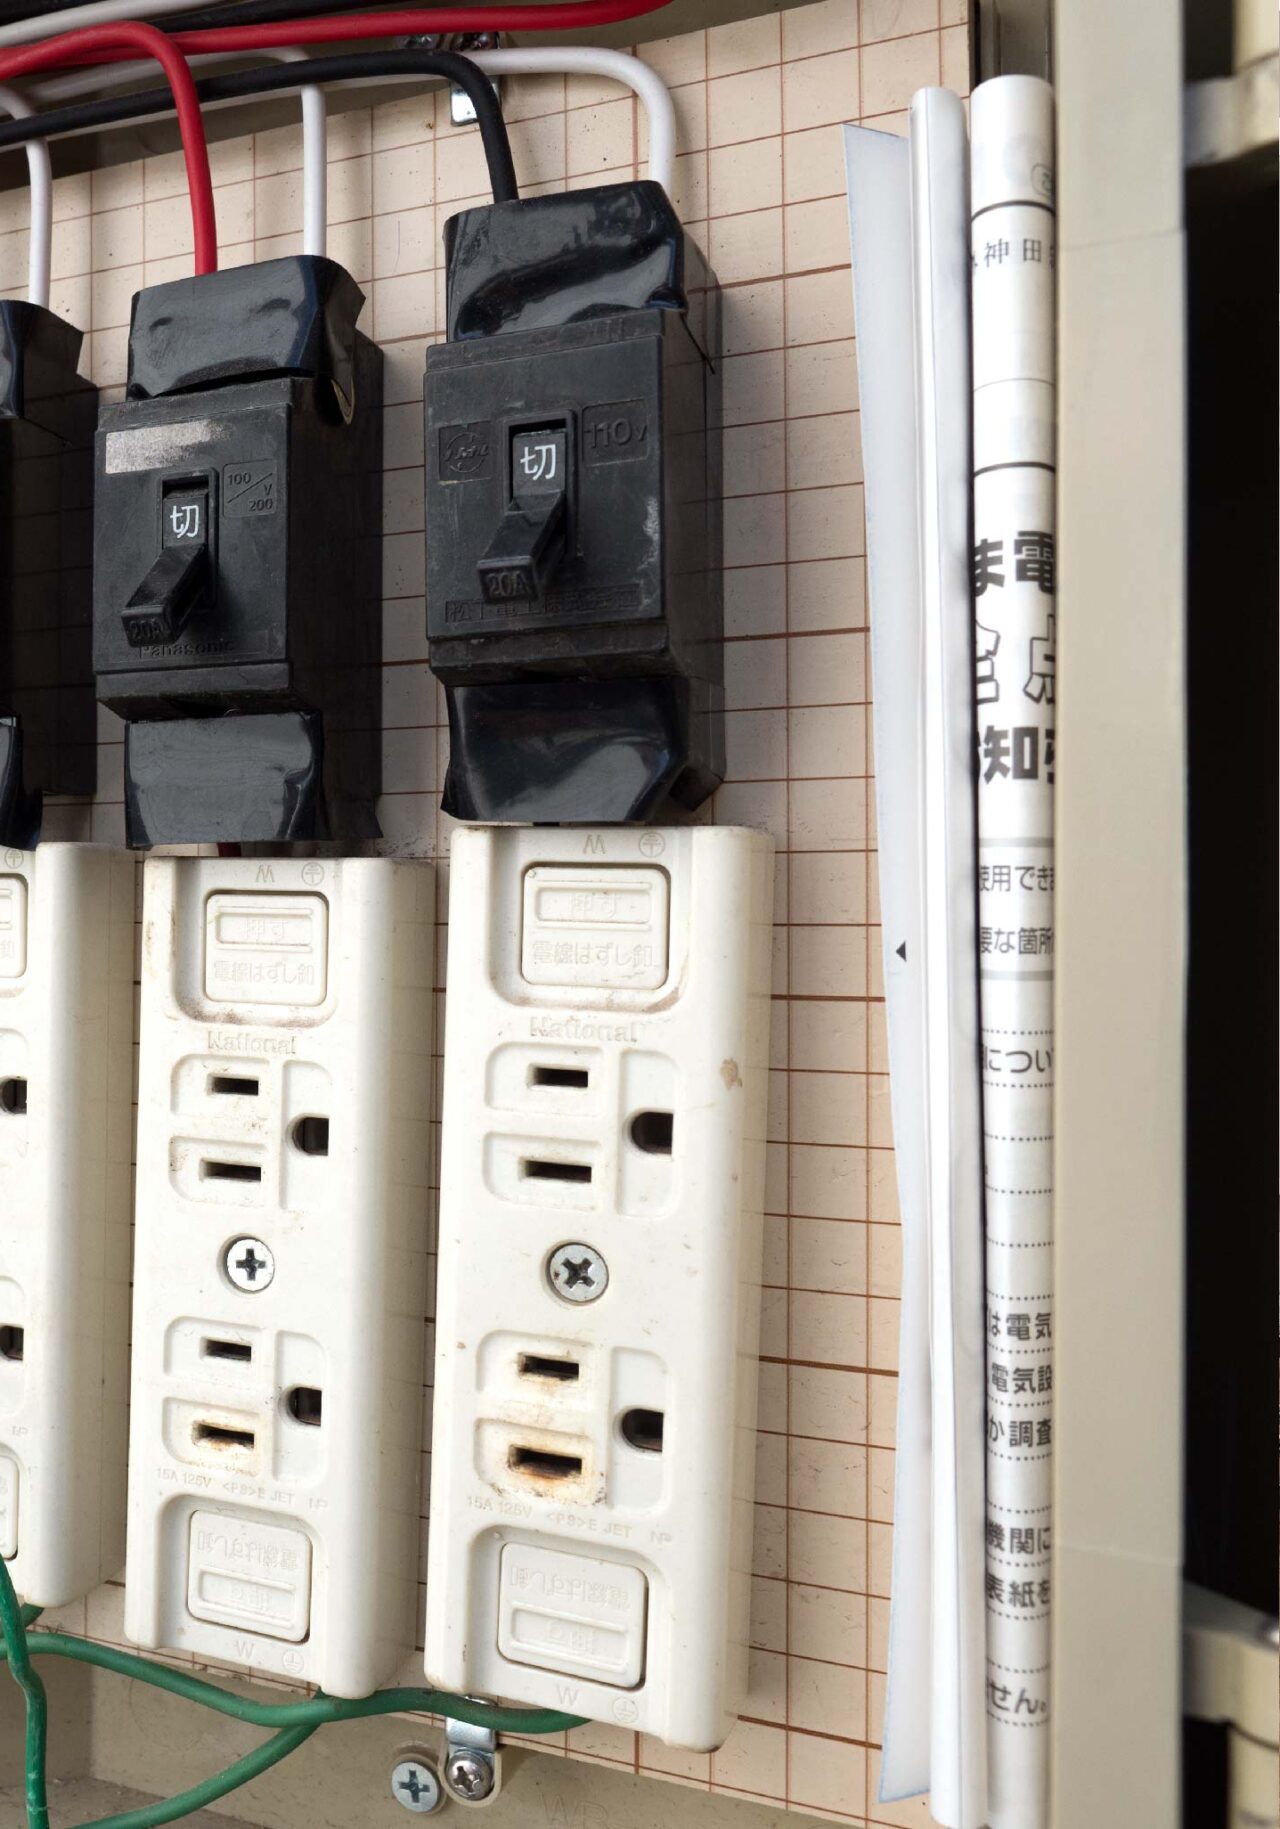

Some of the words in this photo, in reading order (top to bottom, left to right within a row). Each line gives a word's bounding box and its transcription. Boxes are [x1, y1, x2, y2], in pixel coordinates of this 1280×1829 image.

[519, 443, 557, 481] 切
[226, 471, 253, 487] 100
[248, 498, 274, 512] 200
[169, 504, 201, 539] 切
[487, 570, 529, 597] 20A
[529, 1014, 638, 1043] National
[207, 1030, 297, 1056] National
